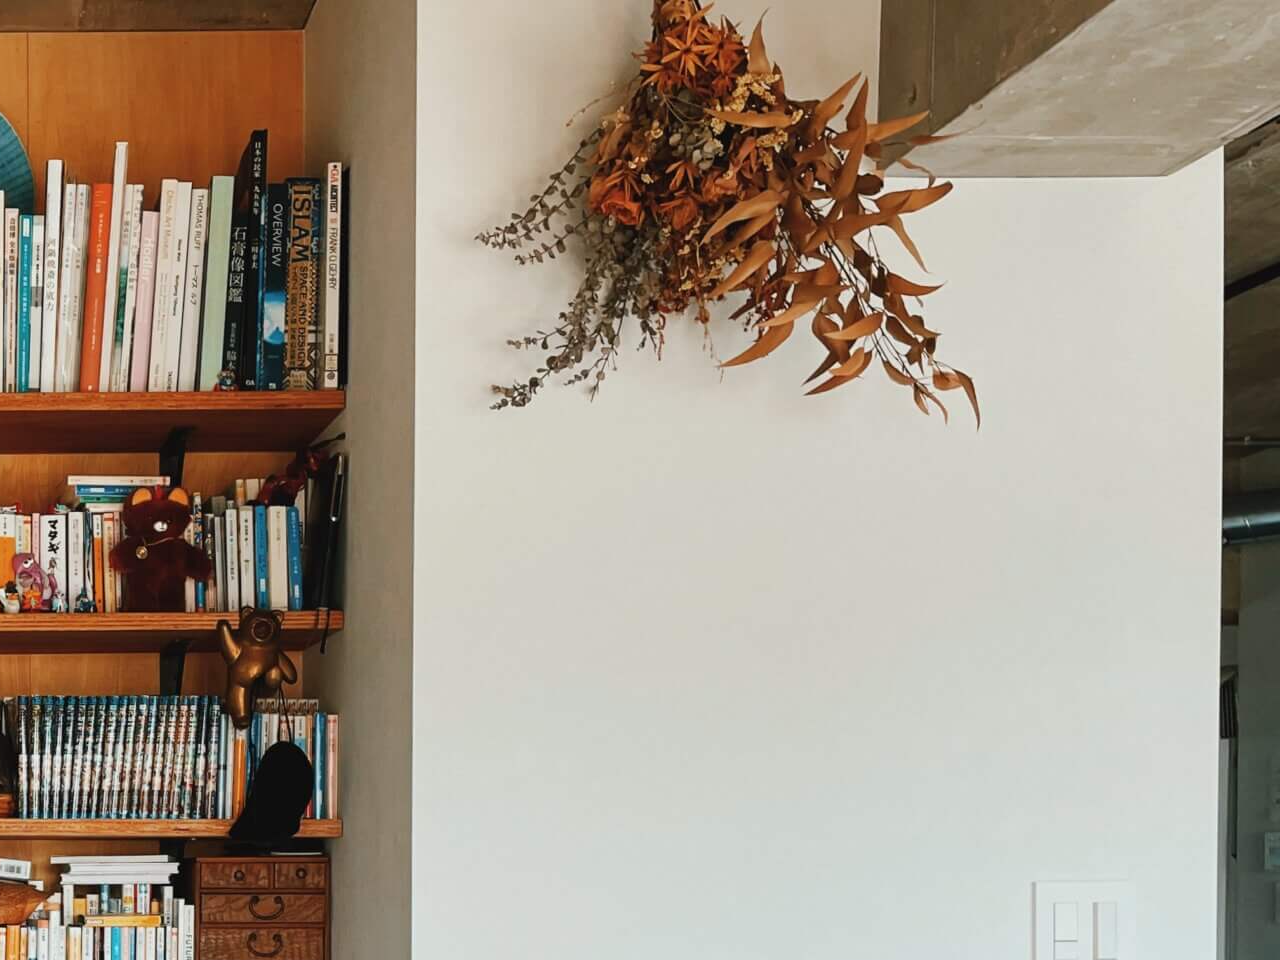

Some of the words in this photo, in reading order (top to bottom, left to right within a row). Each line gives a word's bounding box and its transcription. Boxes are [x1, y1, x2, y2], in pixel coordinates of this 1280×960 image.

[195, 195, 204, 229] THOMAS
[292, 188, 312, 263] ISLAM
[272, 203, 284, 267] OVERVIEW
[329, 227, 337, 253] FRANK
[229, 226, 246, 303] 石膏像図鑑
[298, 266, 308, 298] SPACE
[329, 263, 337, 290] GEHRY
[298, 301, 308, 325] AND
[298, 327, 308, 367] DESIGN
[47, 519, 61, 555] マタギ
